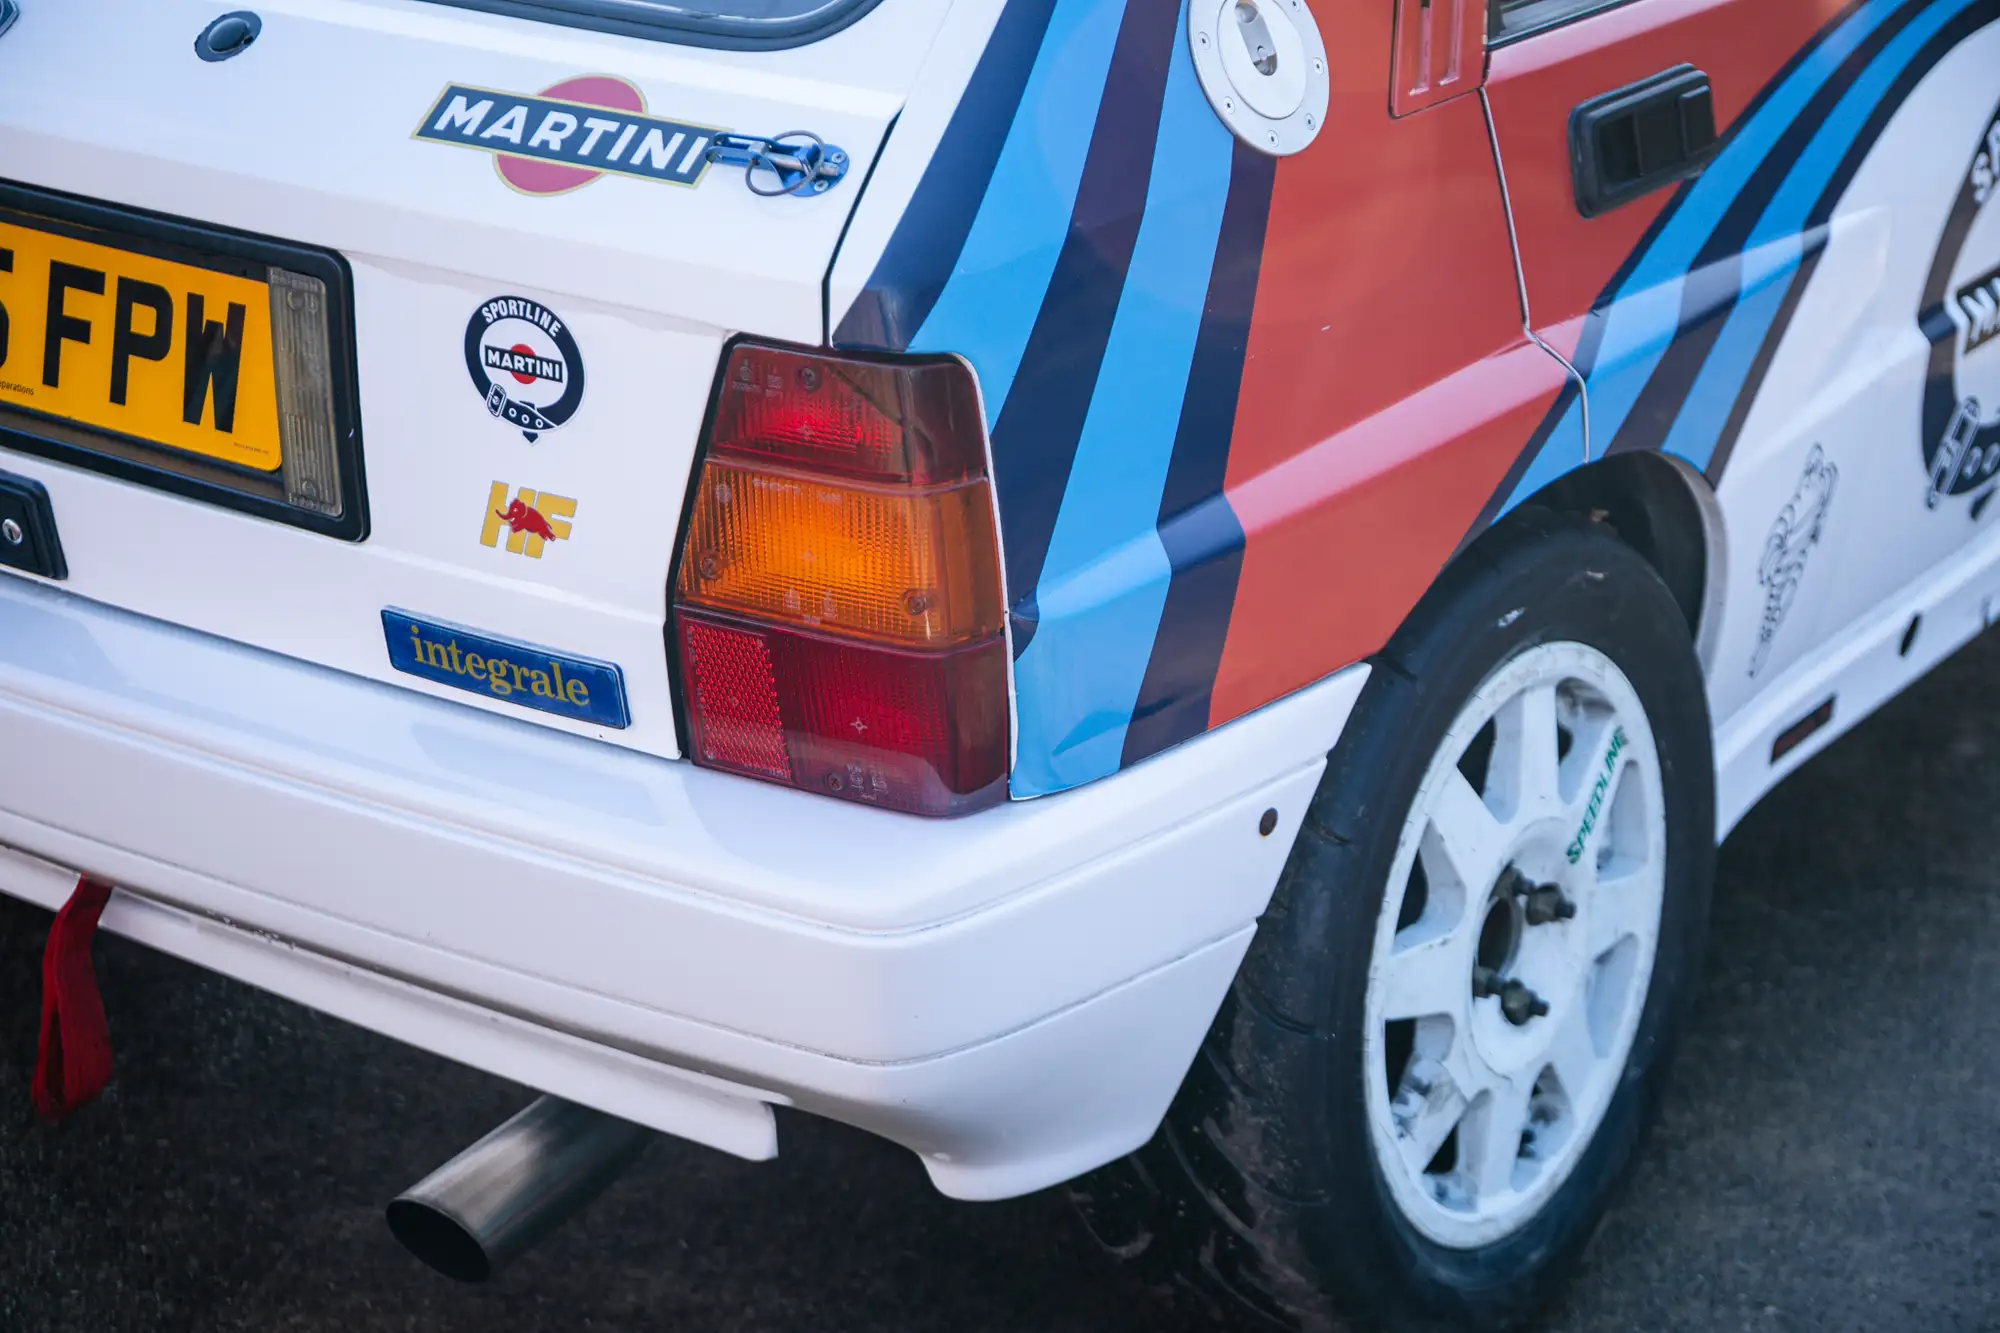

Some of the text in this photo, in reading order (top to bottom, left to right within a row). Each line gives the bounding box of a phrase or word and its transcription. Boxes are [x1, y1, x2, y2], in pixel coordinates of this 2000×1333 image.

[433, 95, 709, 174] MARTINI
[42, 259, 247, 434] FPW
[481, 299, 562, 338] SPORTLINE
[486, 349, 562, 381] MARTINI
[479, 480, 578, 559] HF
[410, 625, 590, 707] integrale
[1566, 725, 1625, 865] SPEEDLINE
